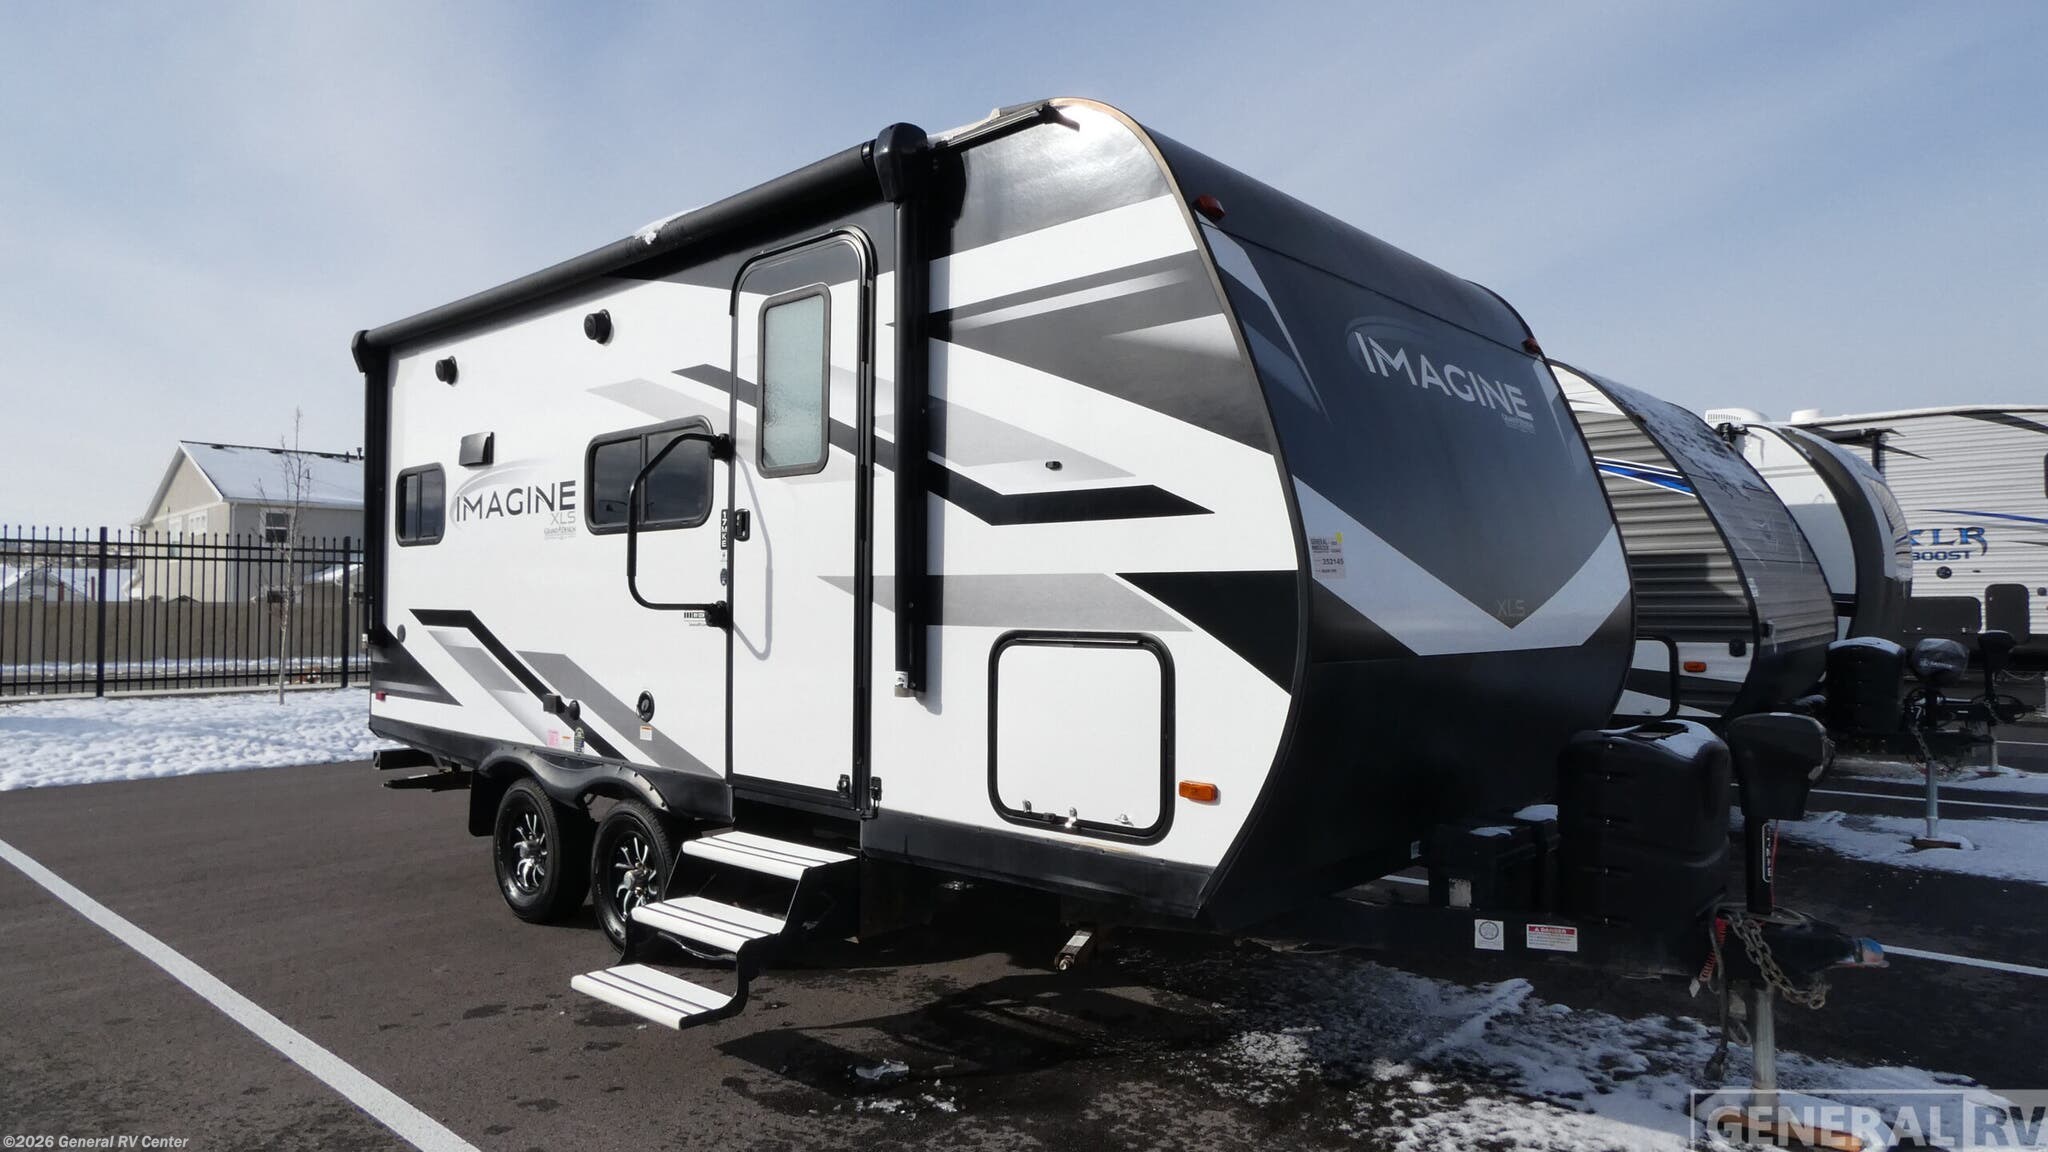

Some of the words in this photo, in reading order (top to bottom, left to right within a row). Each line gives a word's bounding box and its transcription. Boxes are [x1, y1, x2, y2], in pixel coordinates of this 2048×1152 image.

[1355, 331, 1534, 421] IMAGINE
[457, 480, 576, 522] IMAGINE
[550, 511, 576, 526] XLS
[1496, 599, 1526, 617] XLS
